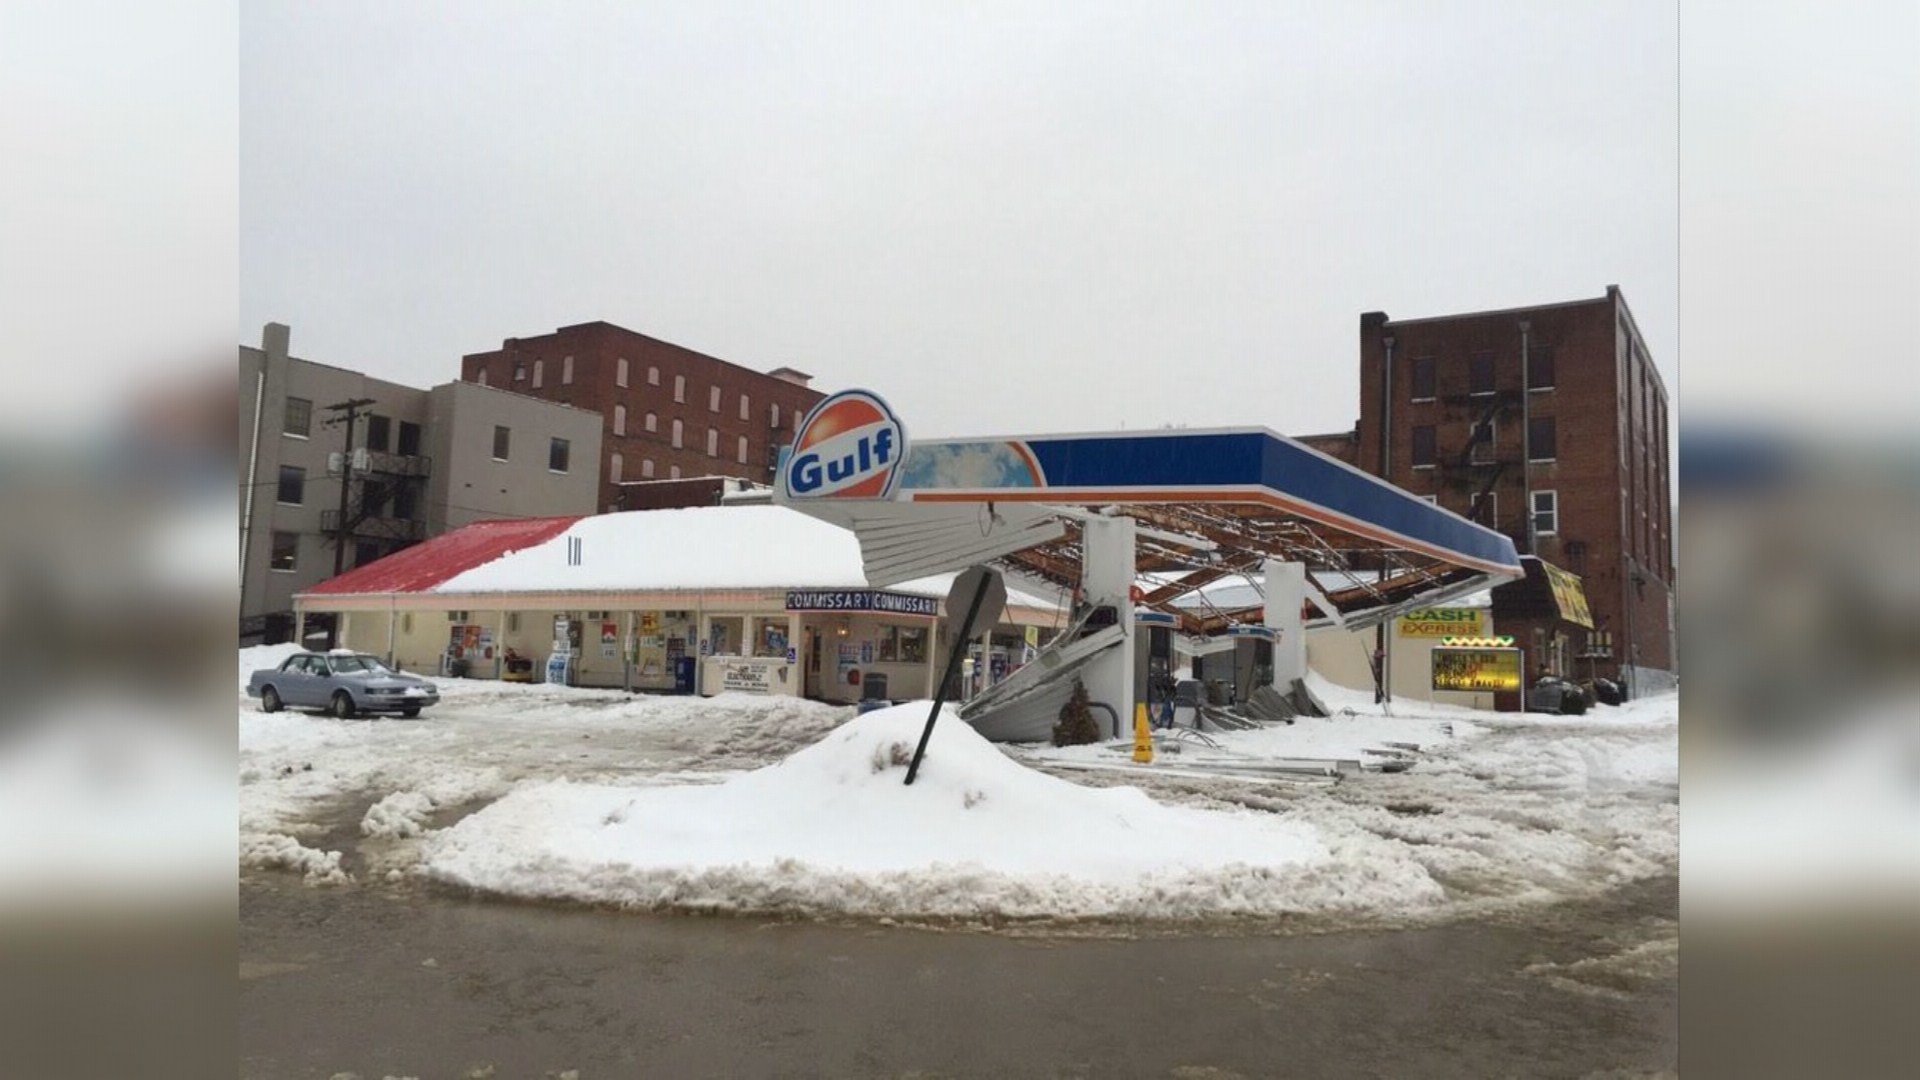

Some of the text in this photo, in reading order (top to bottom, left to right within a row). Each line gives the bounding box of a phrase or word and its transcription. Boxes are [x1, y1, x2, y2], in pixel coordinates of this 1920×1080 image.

[791, 428, 892, 493] Gulf
[787, 592, 936, 613] COMMISSARY COMMISSARY
[1405, 609, 1476, 621] CASH
[1403, 622, 1479, 634] EXPRESS
